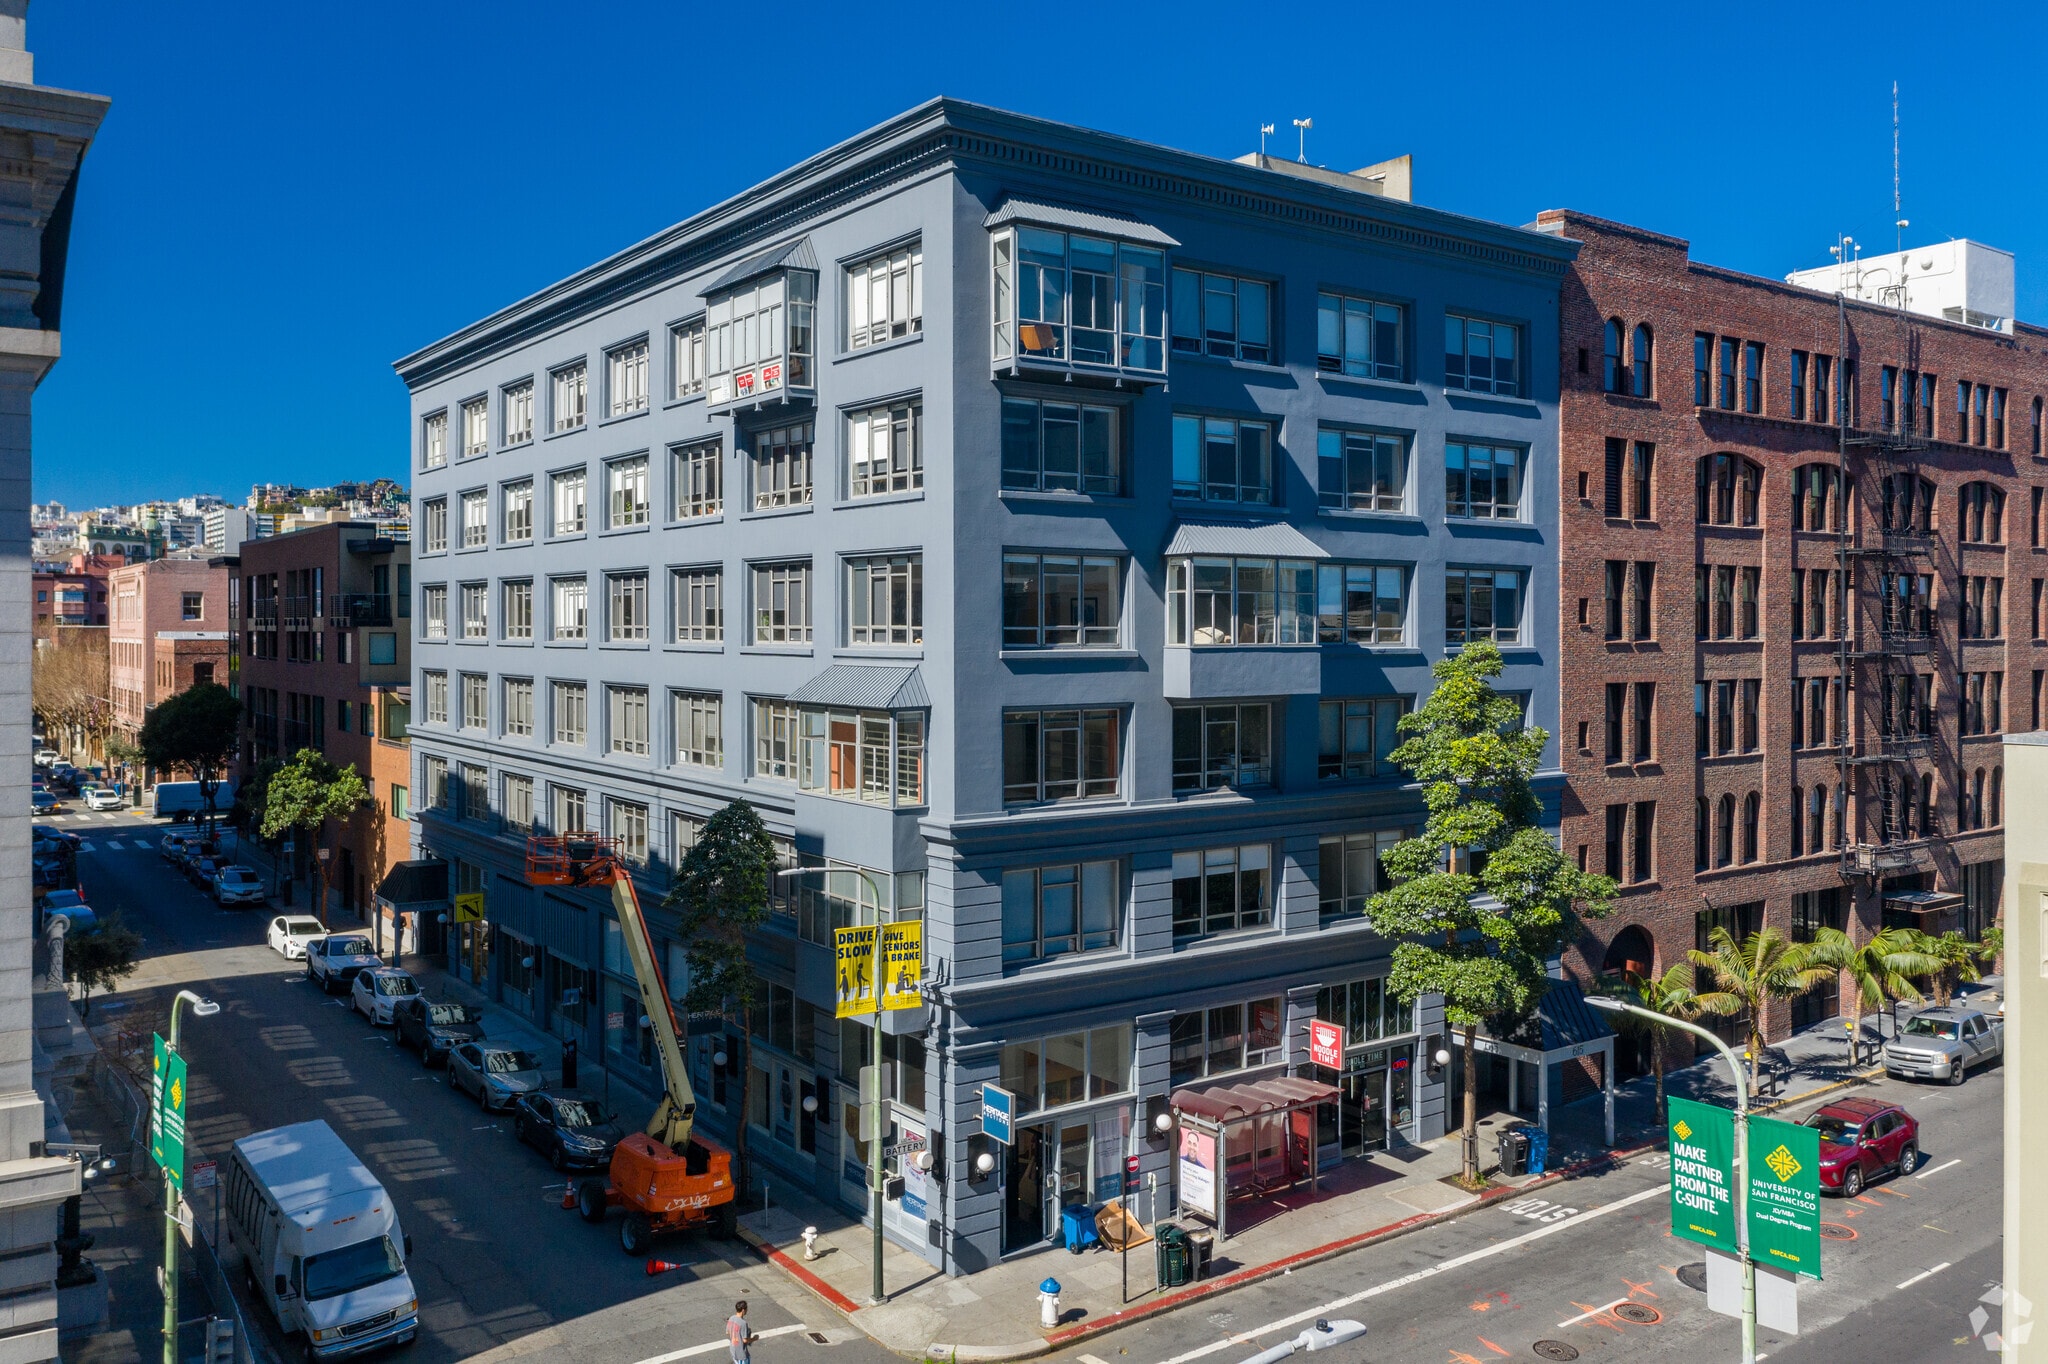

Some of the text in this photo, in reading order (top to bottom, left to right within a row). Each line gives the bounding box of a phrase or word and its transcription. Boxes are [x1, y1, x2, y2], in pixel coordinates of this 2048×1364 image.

[838, 930, 873, 944] DRIVE
[884, 931, 904, 942] GIVE
[838, 944, 872, 959] SLOW
[883, 941, 920, 952] SENIORS
[883, 951, 920, 963] A BRAKE
[1313, 1044, 1338, 1058] NOODLE
[1318, 1052, 1335, 1065] TIME
[1367, 1050, 1384, 1062] TIME
[1572, 1046, 1584, 1056] 615
[983, 1103, 1009, 1121] HERITAGE
[886, 1141, 925, 1156] BATTERY
[1674, 1141, 1707, 1163] MAKE
[1674, 1157, 1723, 1185] PARTNER
[1675, 1173, 1729, 1203] FROM THE
[1752, 1178, 1816, 1200] UNIVERSITY OF
[1675, 1190, 1719, 1215] C-SUITE.
[1751, 1188, 1816, 1210] SAN FRANCISCO
[1498, 1198, 1578, 1223] STOP
[1772, 1207, 1795, 1218] JD/MBA
[1756, 1211, 1812, 1231] Dual Degree Program
[1689, 1223, 1717, 1237] USFCA.EDU
[1769, 1247, 1800, 1263] USFCA.EDU
